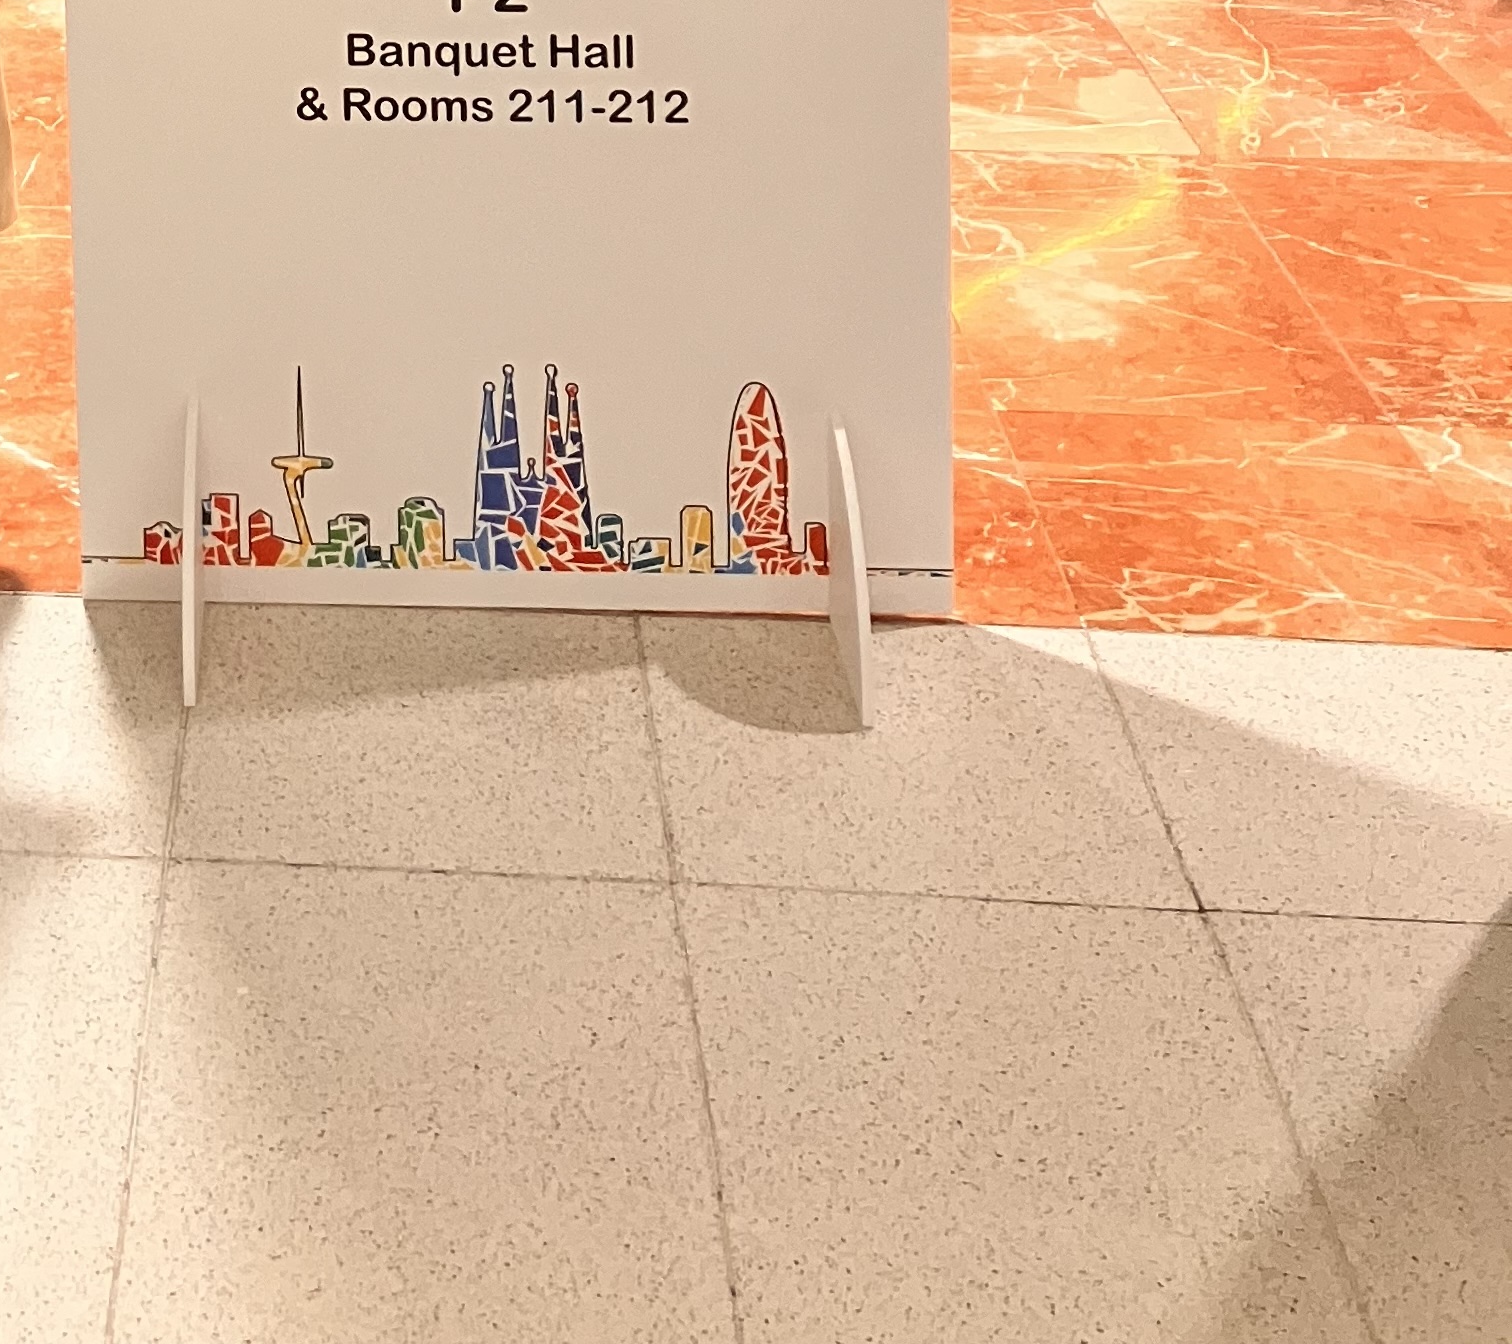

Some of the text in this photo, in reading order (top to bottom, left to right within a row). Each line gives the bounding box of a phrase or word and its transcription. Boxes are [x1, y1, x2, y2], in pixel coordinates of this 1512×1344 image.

[347, 33, 634, 77] Banquet Hall
[296, 86, 689, 124] & Rooms 211-212
